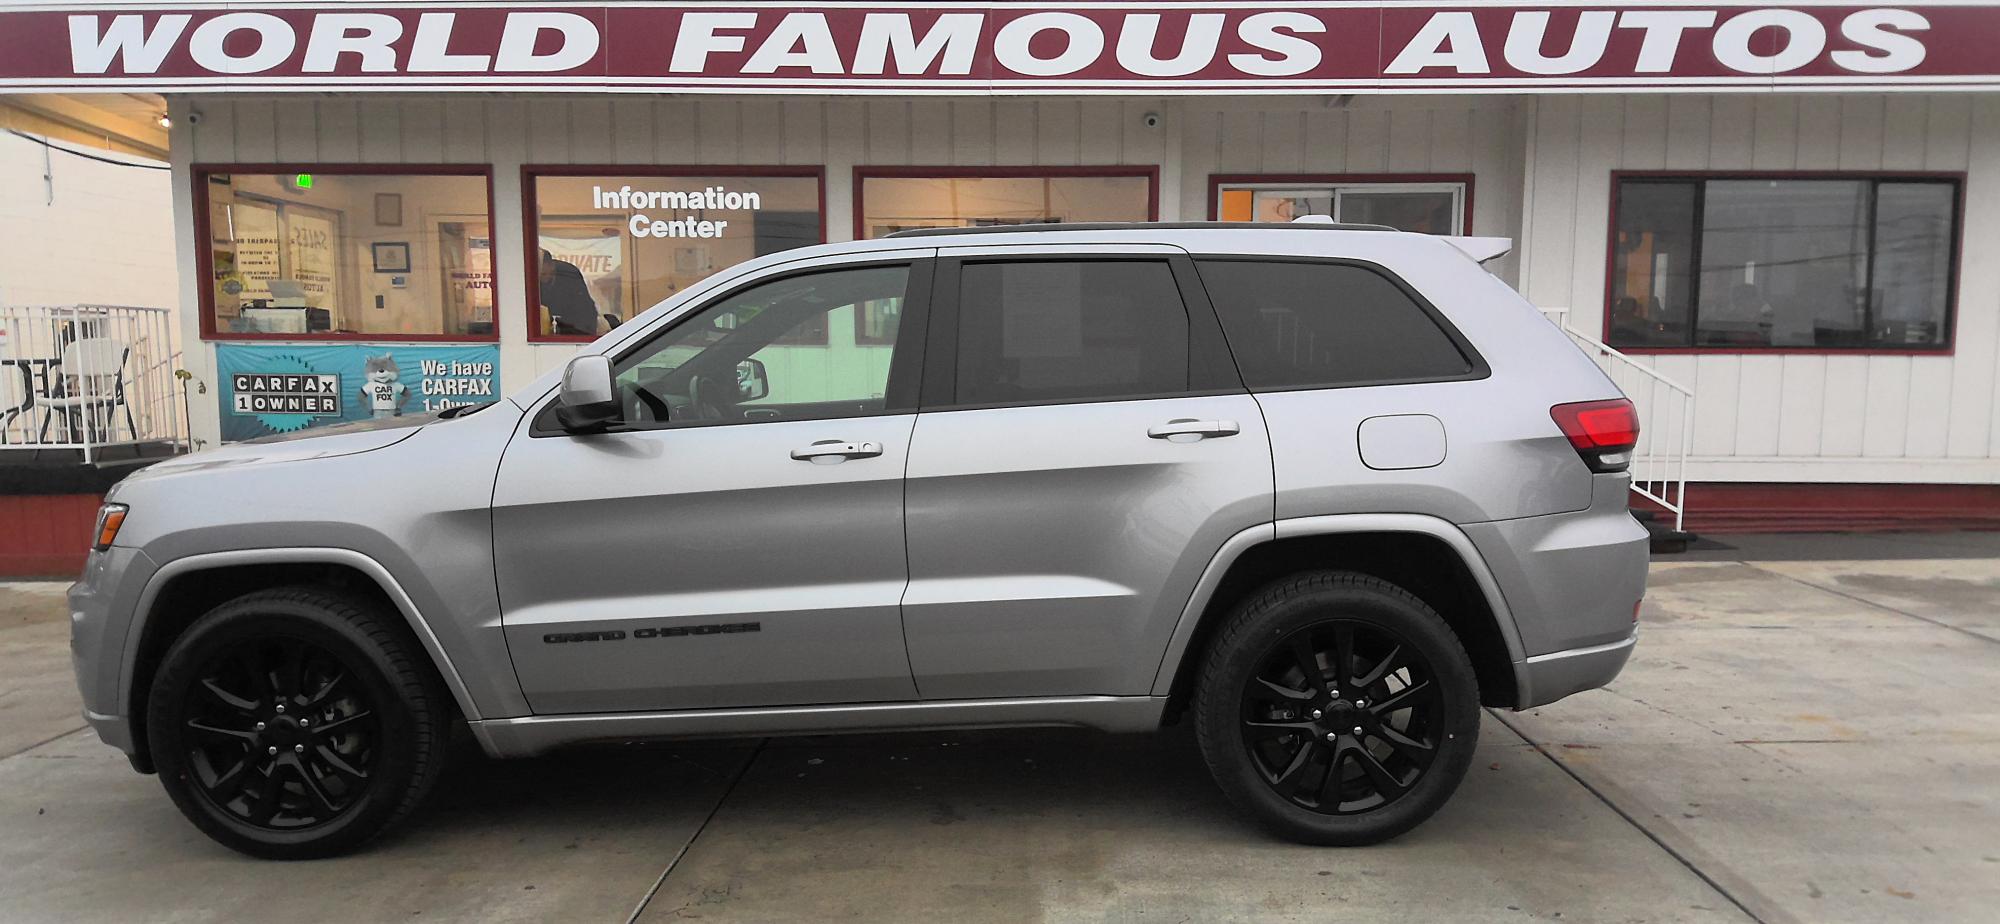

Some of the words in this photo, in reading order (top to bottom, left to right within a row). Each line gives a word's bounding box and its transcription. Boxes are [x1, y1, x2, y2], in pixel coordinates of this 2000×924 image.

[68, 12, 601, 74] WORLD
[668, 11, 1328, 77] FAMOUS
[1382, 8, 1931, 75] AUTOS
[593, 185, 761, 210] Information
[629, 214, 728, 238] Center
[555, 254, 613, 273] IVATE
[420, 360, 448, 376] We
[451, 360, 492, 376] have
[235, 376, 335, 394] CARFAX
[374, 385, 393, 393] CAR
[421, 379, 493, 396] CARFAX
[376, 393, 393, 402] FOX
[543, 630, 626, 644] GRAND
[633, 622, 761, 639] CHEROKEE
